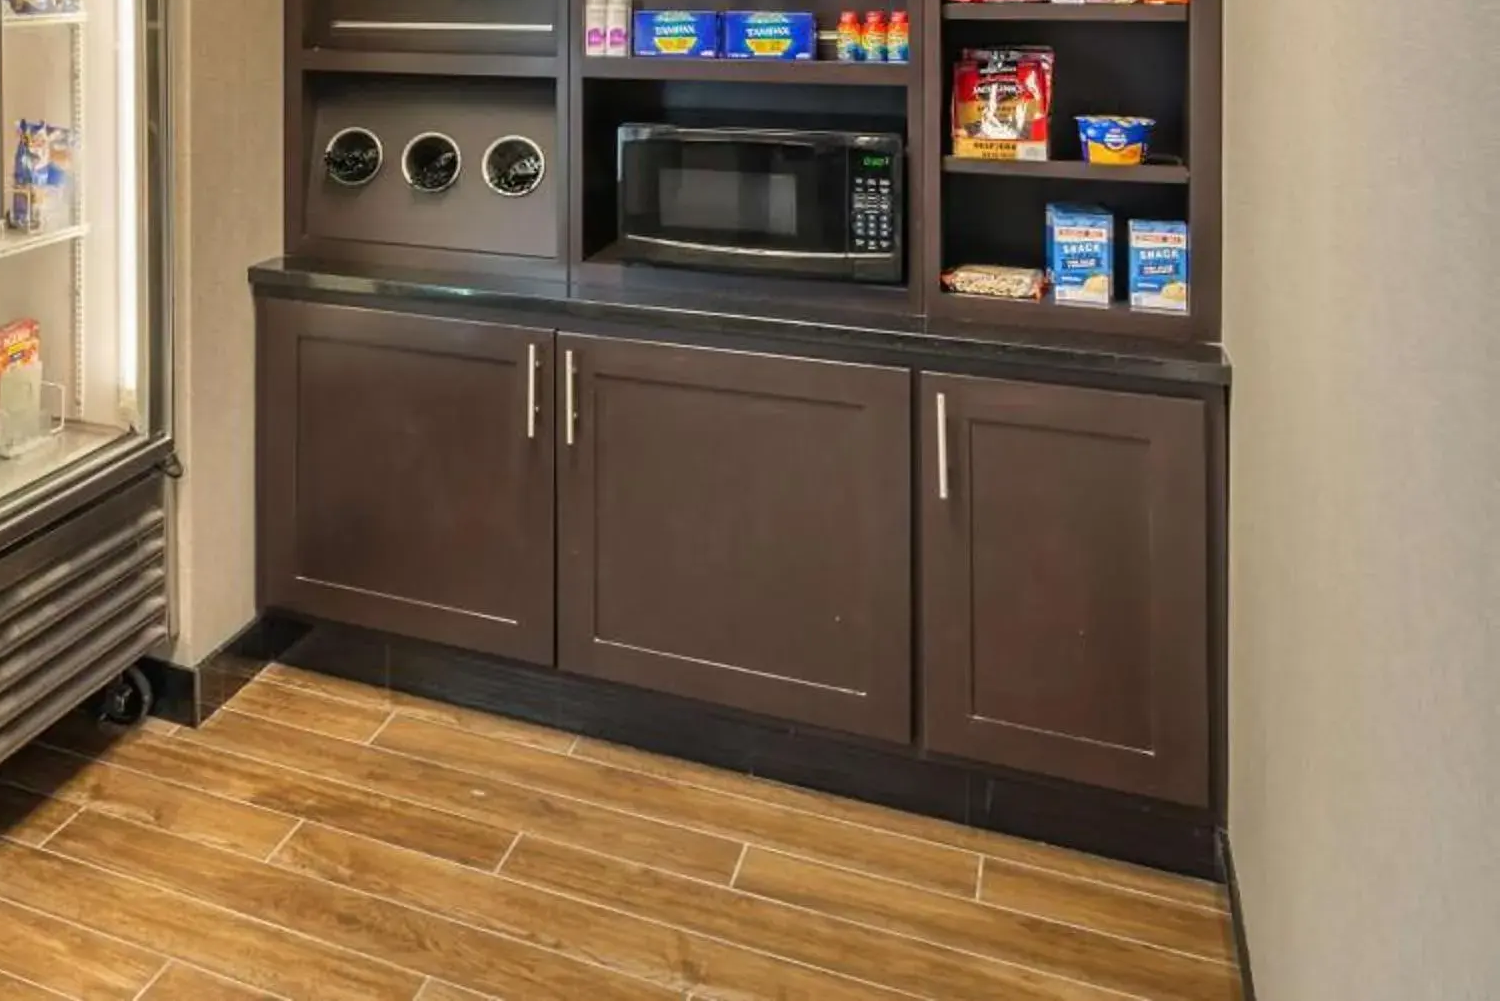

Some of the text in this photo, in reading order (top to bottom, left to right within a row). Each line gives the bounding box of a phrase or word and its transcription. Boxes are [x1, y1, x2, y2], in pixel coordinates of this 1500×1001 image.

[655, 25, 696, 36] TAMPAX
[1062, 243, 1100, 254] SNACK
[1140, 249, 1180, 260] SNACK
